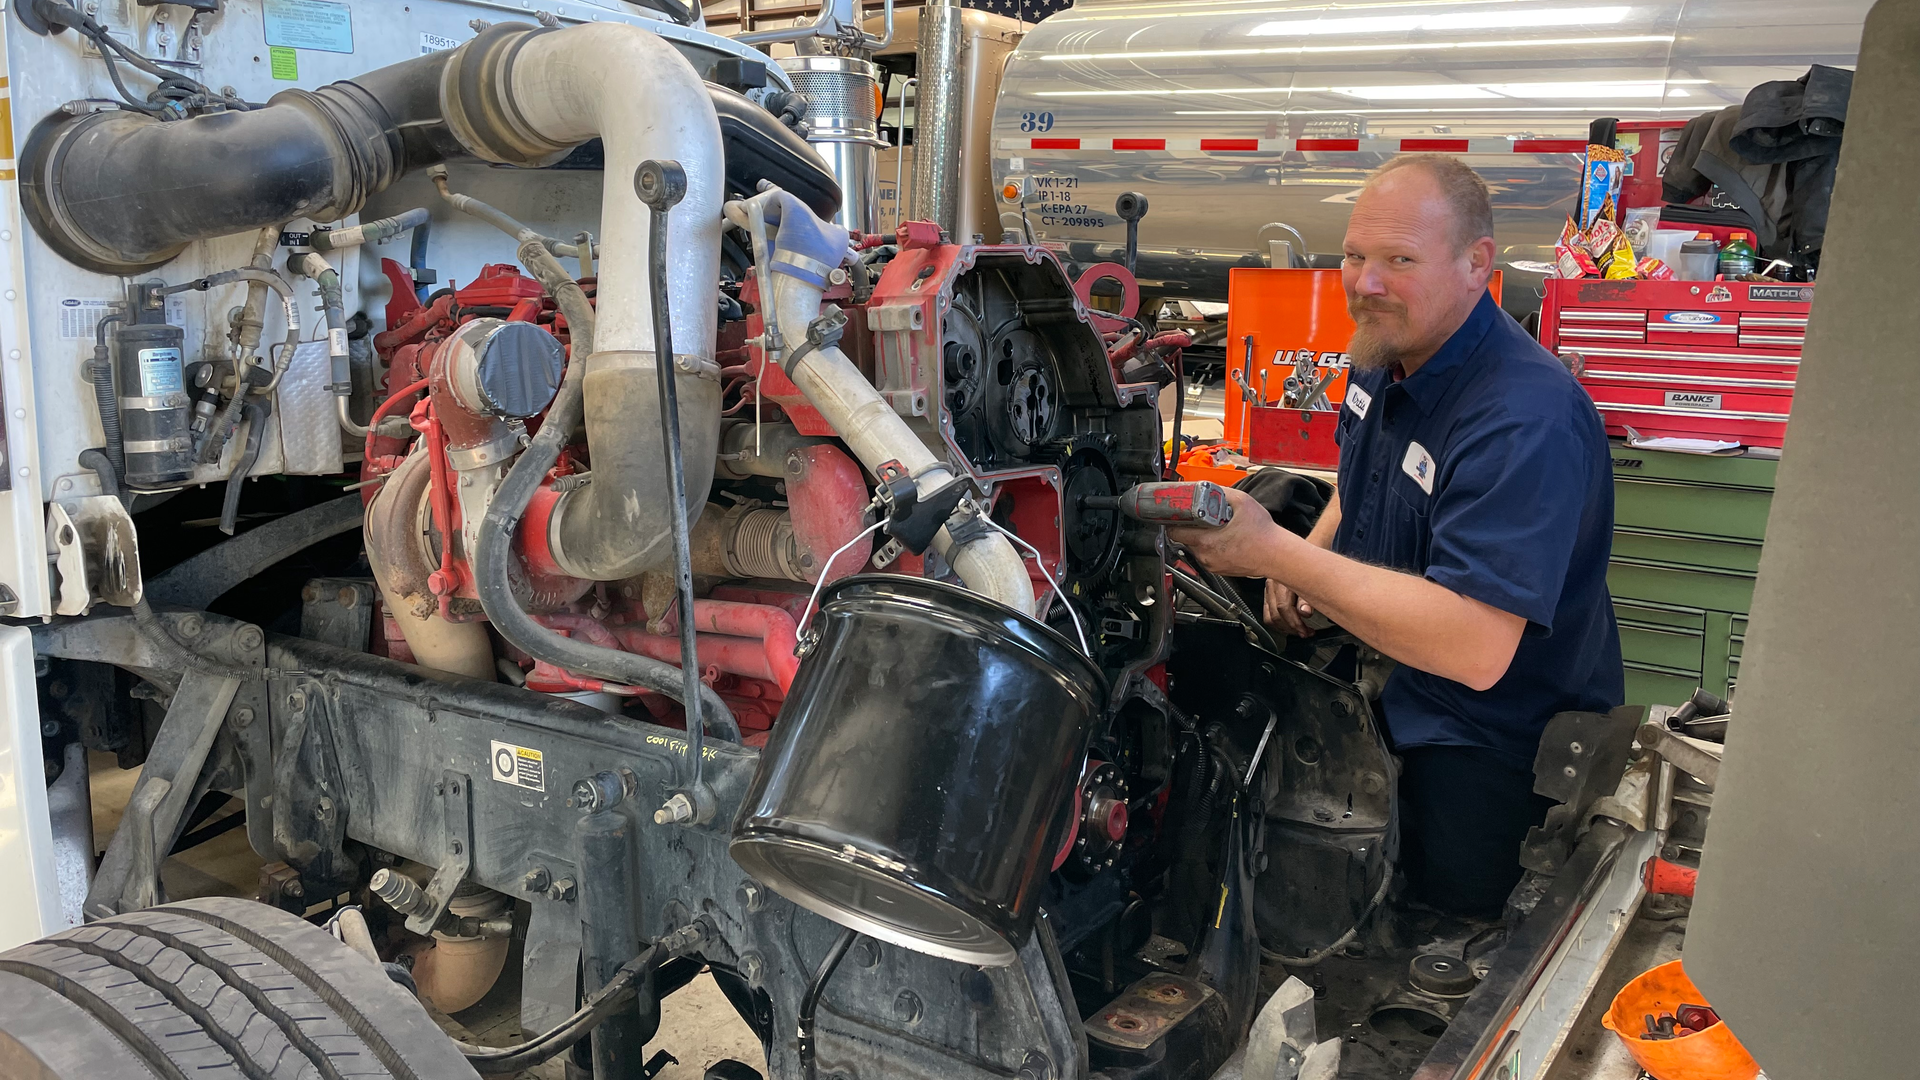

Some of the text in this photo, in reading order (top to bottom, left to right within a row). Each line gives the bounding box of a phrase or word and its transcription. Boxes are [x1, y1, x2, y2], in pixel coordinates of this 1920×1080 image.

[424, 34, 456, 49] 189513
[1020, 111, 1054, 132] 39
[1036, 177, 1079, 189] VK 1-21
[1038, 190, 1071, 202] IP 1-18
[1041, 204, 1088, 215] K-EPA 27
[1752, 288, 1799, 298] MATCO
[1671, 394, 1715, 403] BANKS
